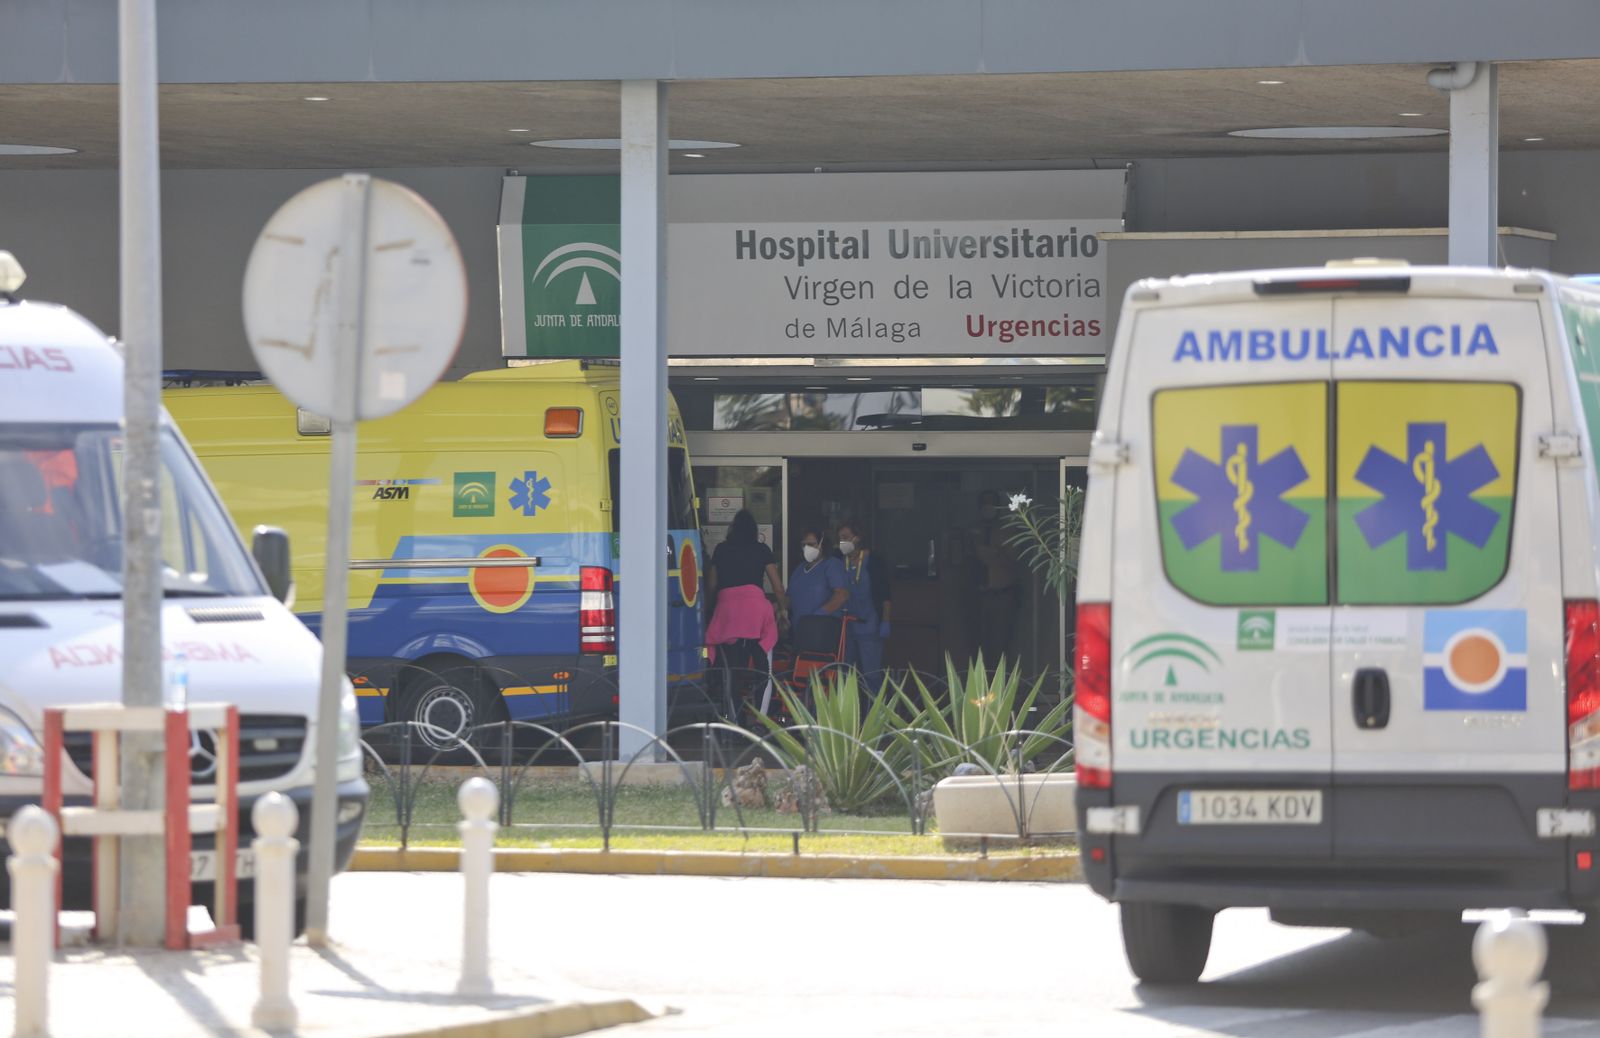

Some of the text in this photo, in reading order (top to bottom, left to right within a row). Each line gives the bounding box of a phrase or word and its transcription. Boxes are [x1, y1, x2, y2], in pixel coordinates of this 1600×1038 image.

[735, 227, 1098, 267] Hospital Universitario
[784, 273, 1100, 306] Virgen de la Victoria
[534, 314, 621, 327] JUNTA DE ANDAL
[785, 317, 921, 343] de Málaga
[966, 313, 1101, 342] Urgencias
[1172, 323, 1499, 362] AMBULANCIA
[373, 486, 409, 500] ASM
[1130, 728, 1311, 749] URGENCIAS
[1200, 796, 1315, 818] 1034 KDV
